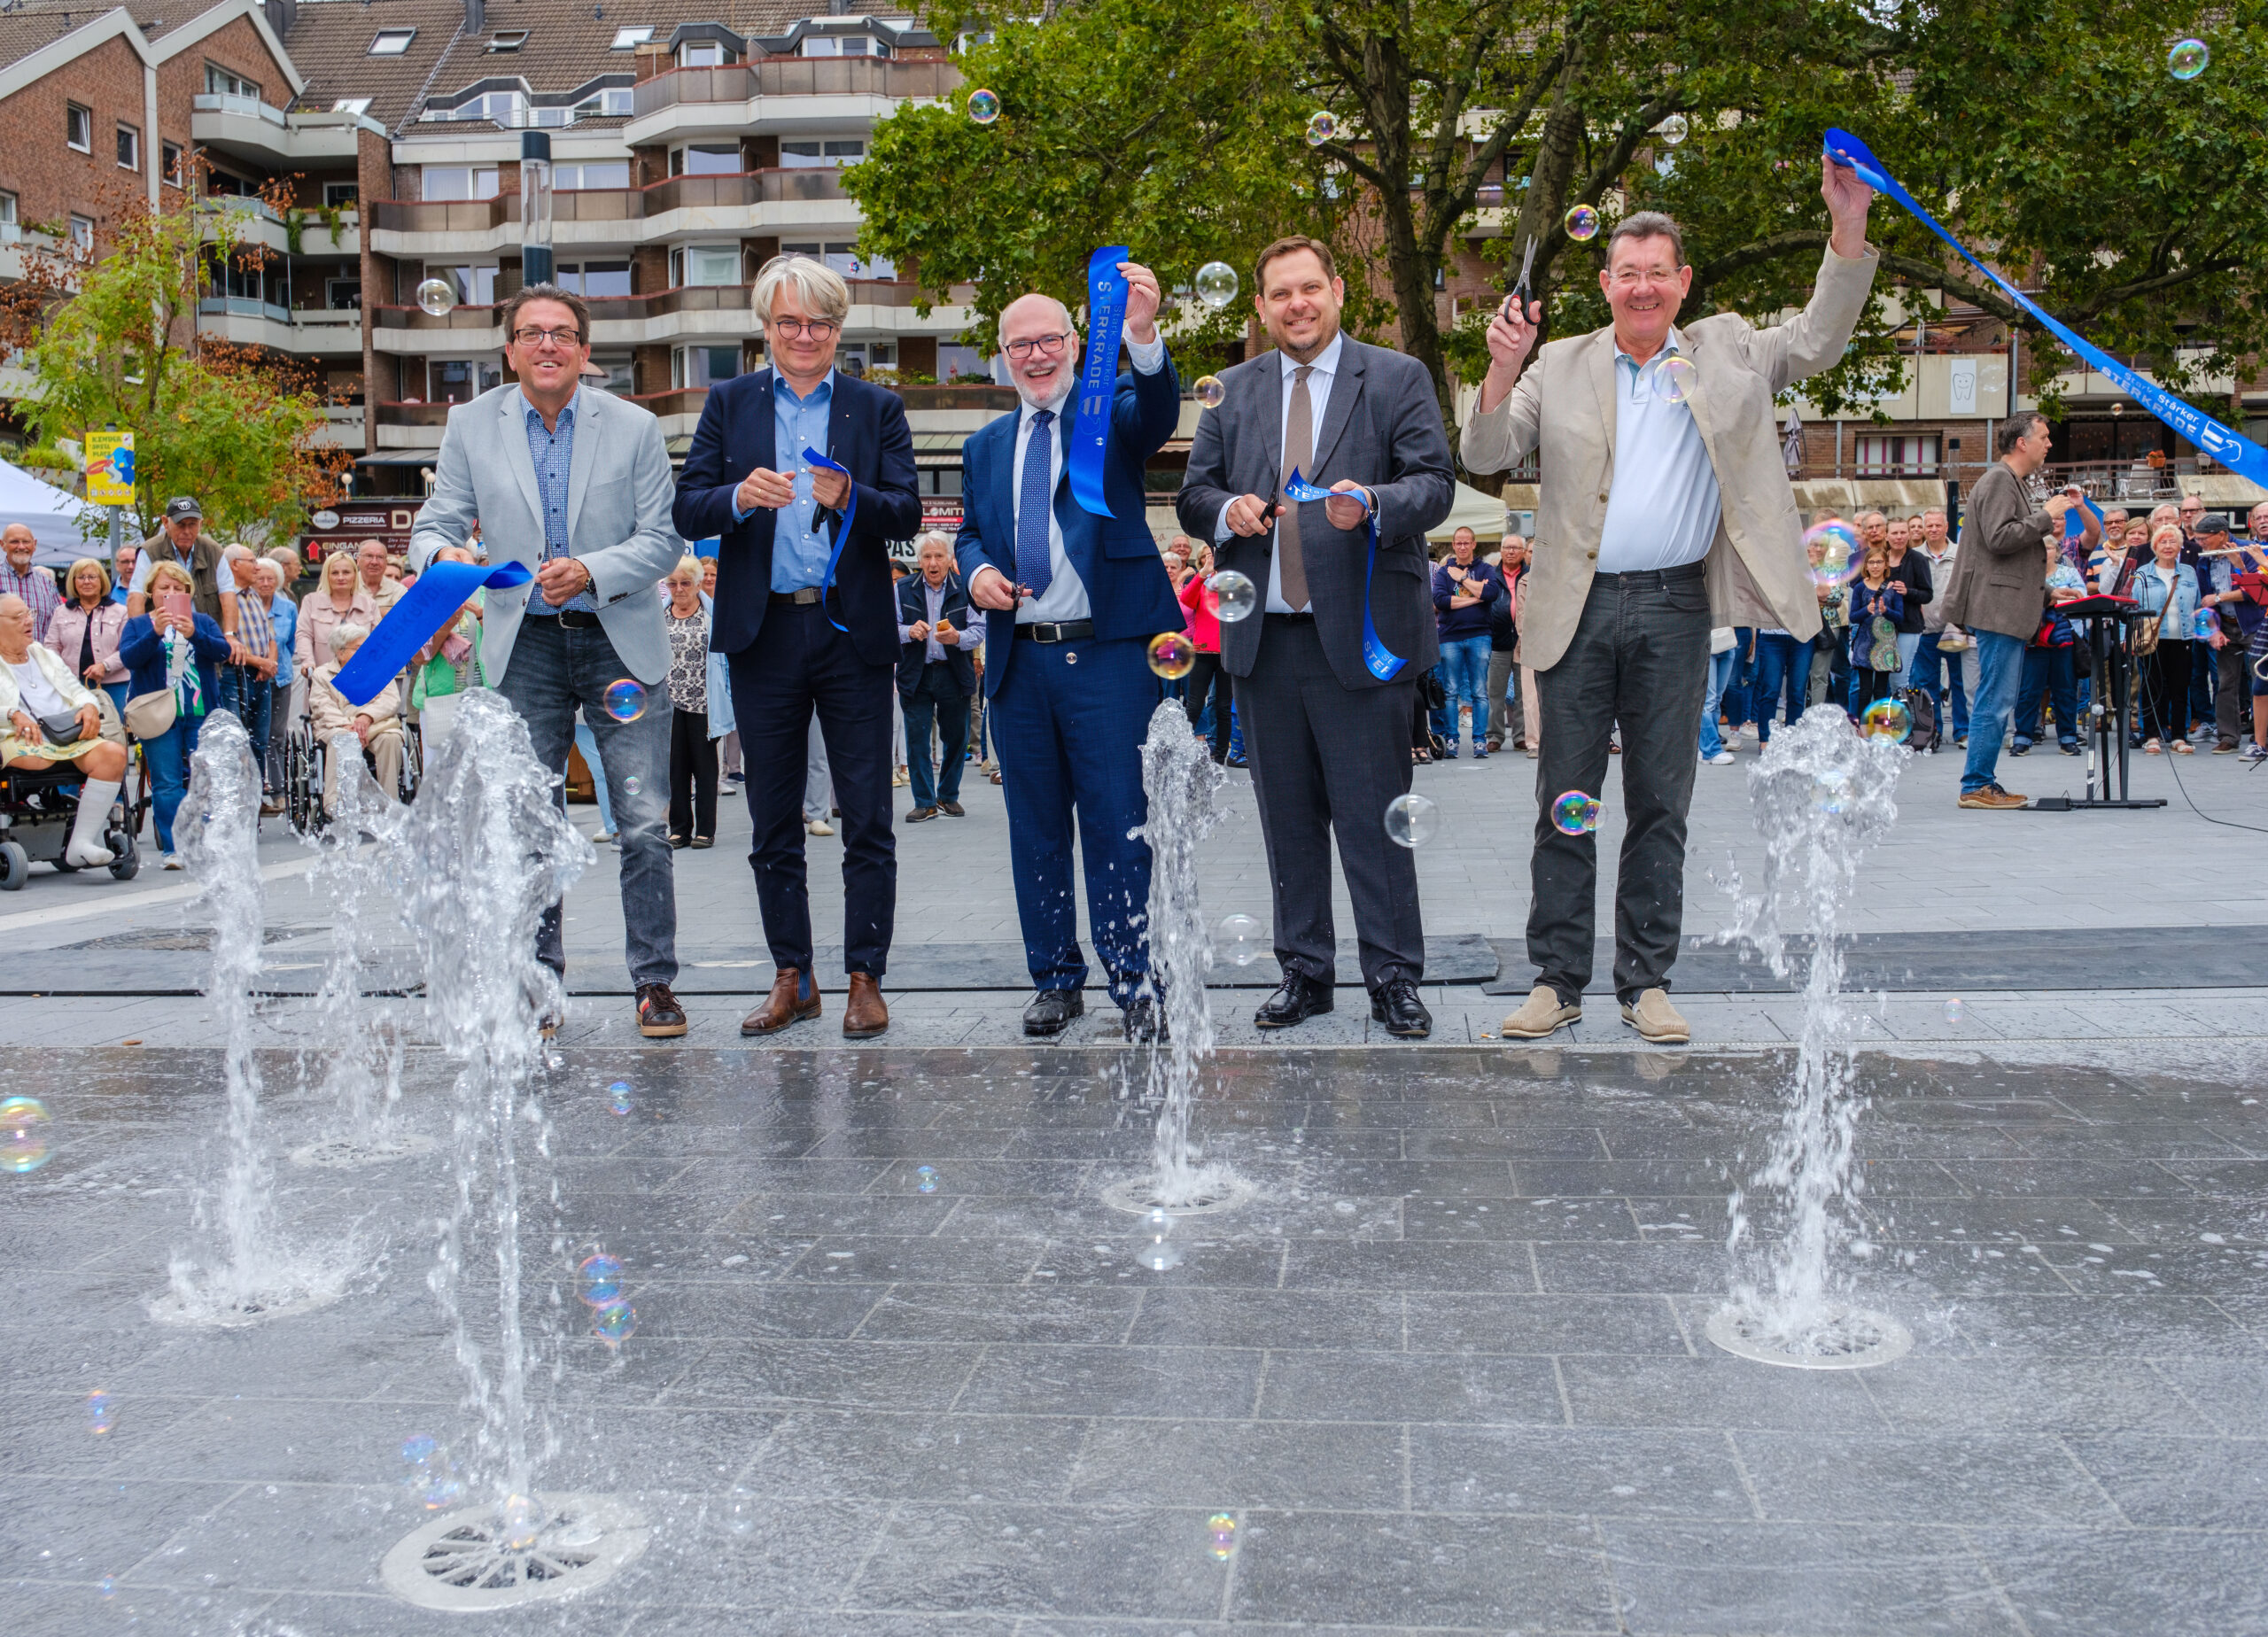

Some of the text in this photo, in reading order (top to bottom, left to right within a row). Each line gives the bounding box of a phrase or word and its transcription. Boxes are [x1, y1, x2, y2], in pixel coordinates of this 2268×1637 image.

[1088, 281, 1113, 389] STERKRADE
[2101, 365, 2198, 437] STERKRADE
[2156, 393, 2200, 426] Stärker.
[923, 507, 964, 516] LOMITI
[322, 541, 360, 550] EINGAN
